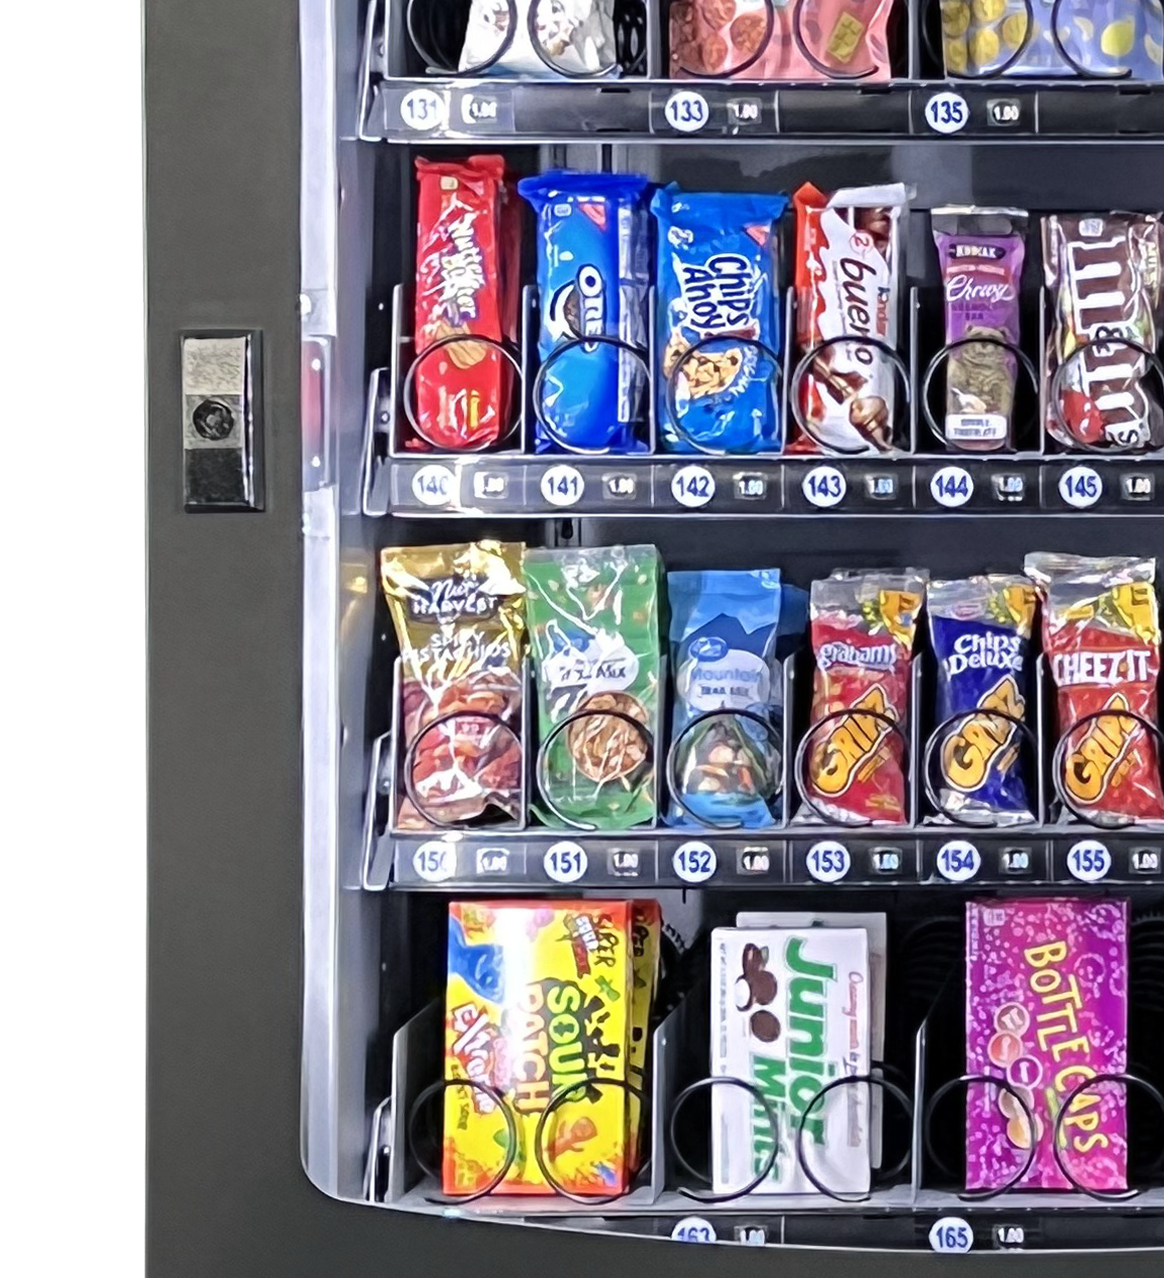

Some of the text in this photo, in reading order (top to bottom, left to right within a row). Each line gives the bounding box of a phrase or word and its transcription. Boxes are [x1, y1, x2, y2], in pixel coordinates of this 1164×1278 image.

[407, 99, 437, 120] 131
[670, 100, 703, 121] 133
[931, 100, 962, 123] 135
[706, 254, 751, 327] Chips
[946, 274, 1014, 303] Chewy
[548, 475, 578, 496] 141
[676, 476, 709, 497] 142
[808, 475, 841, 497] 143
[935, 476, 972, 497] 144
[1065, 475, 1098, 498] 145
[954, 631, 1021, 654] Chips
[946, 650, 1023, 674] Deluxe
[550, 852, 581, 873] 151
[678, 851, 711, 873] 152
[814, 850, 845, 872] 153
[942, 849, 974, 871] 154
[1073, 849, 1104, 872] 155
[547, 986, 588, 1099] SOUR
[786, 936, 835, 1144] Junior
[1024, 941, 1109, 1153] BOTTLE CAPS
[936, 1227, 968, 1247] 165
